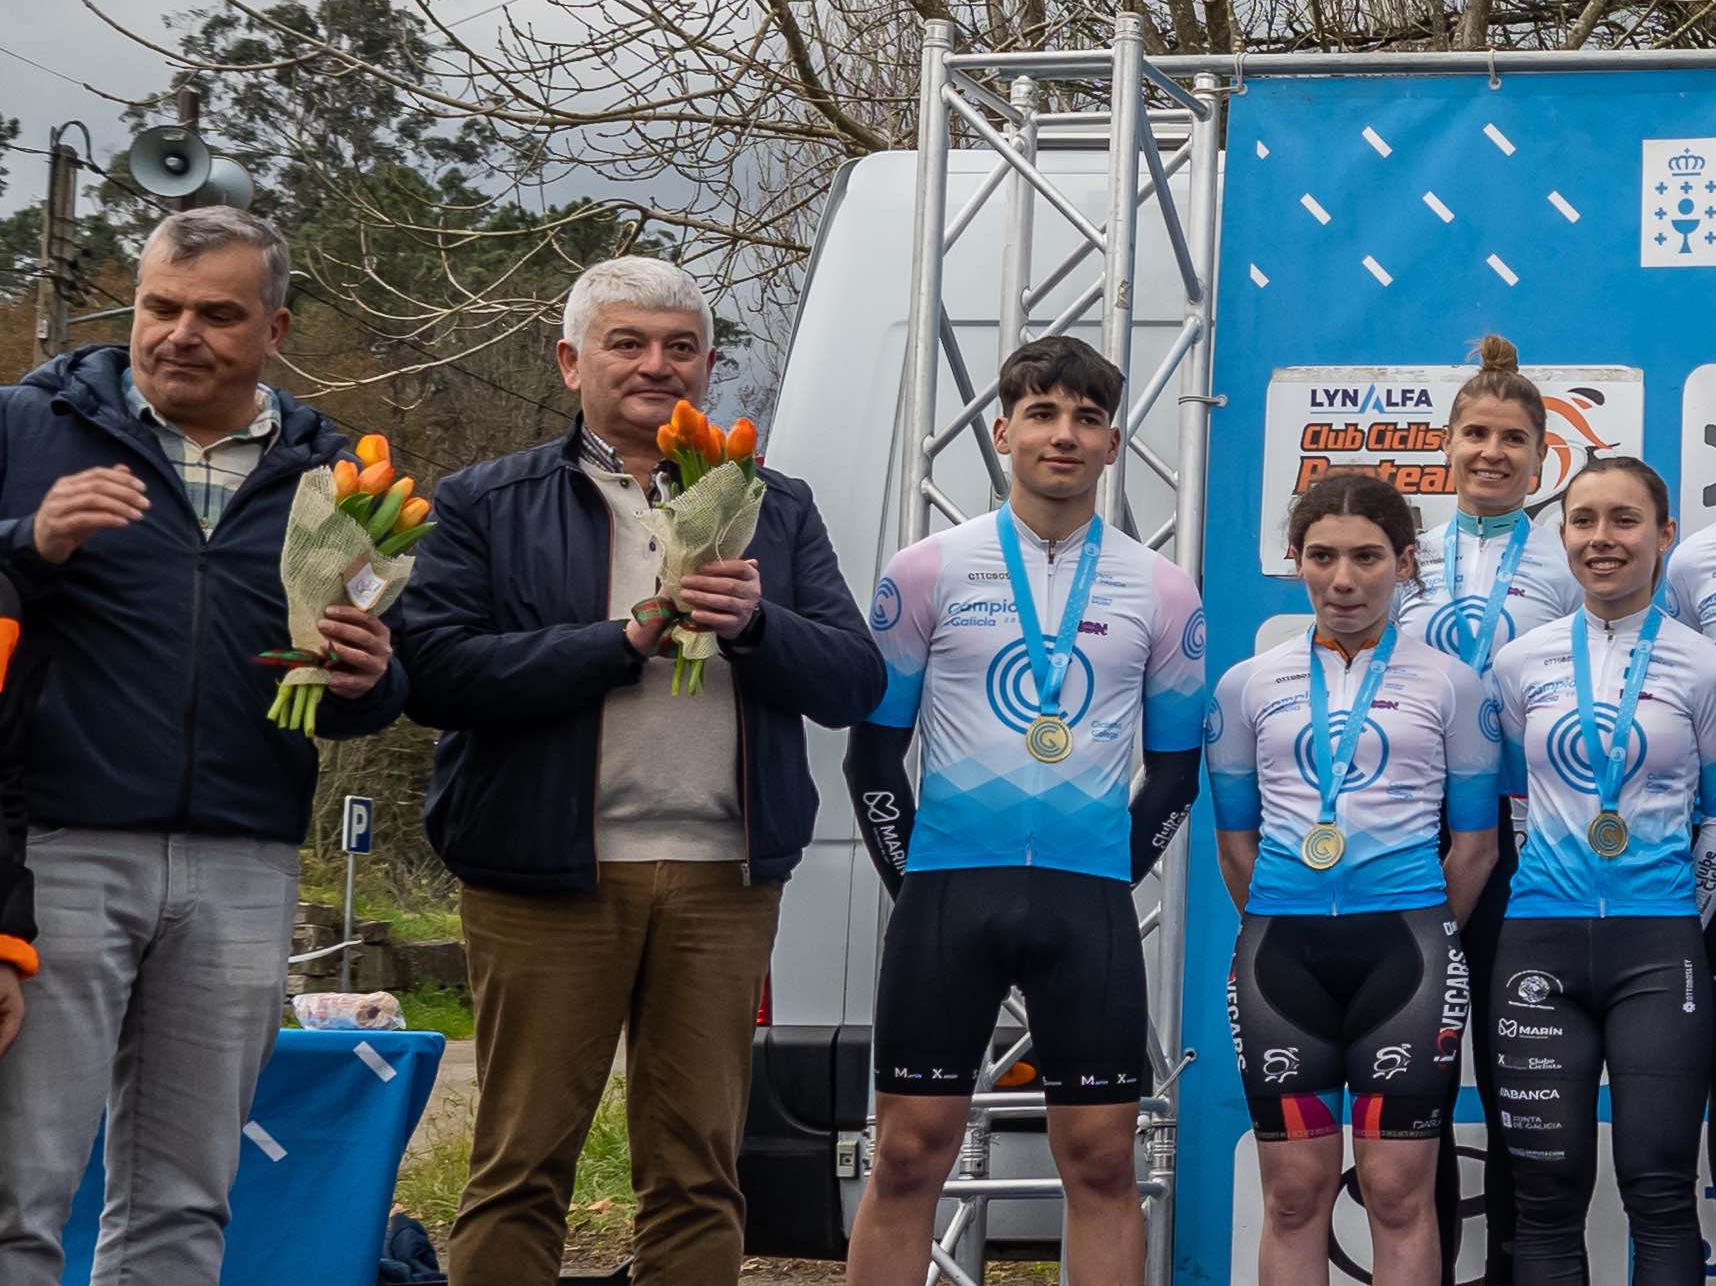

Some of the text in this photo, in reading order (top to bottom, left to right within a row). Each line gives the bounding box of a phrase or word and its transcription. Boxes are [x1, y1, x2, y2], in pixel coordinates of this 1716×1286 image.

[1301, 421, 1448, 451] Club Ciclis
[351, 804, 368, 848] P
[1503, 1089, 1561, 1101] ABANCA
